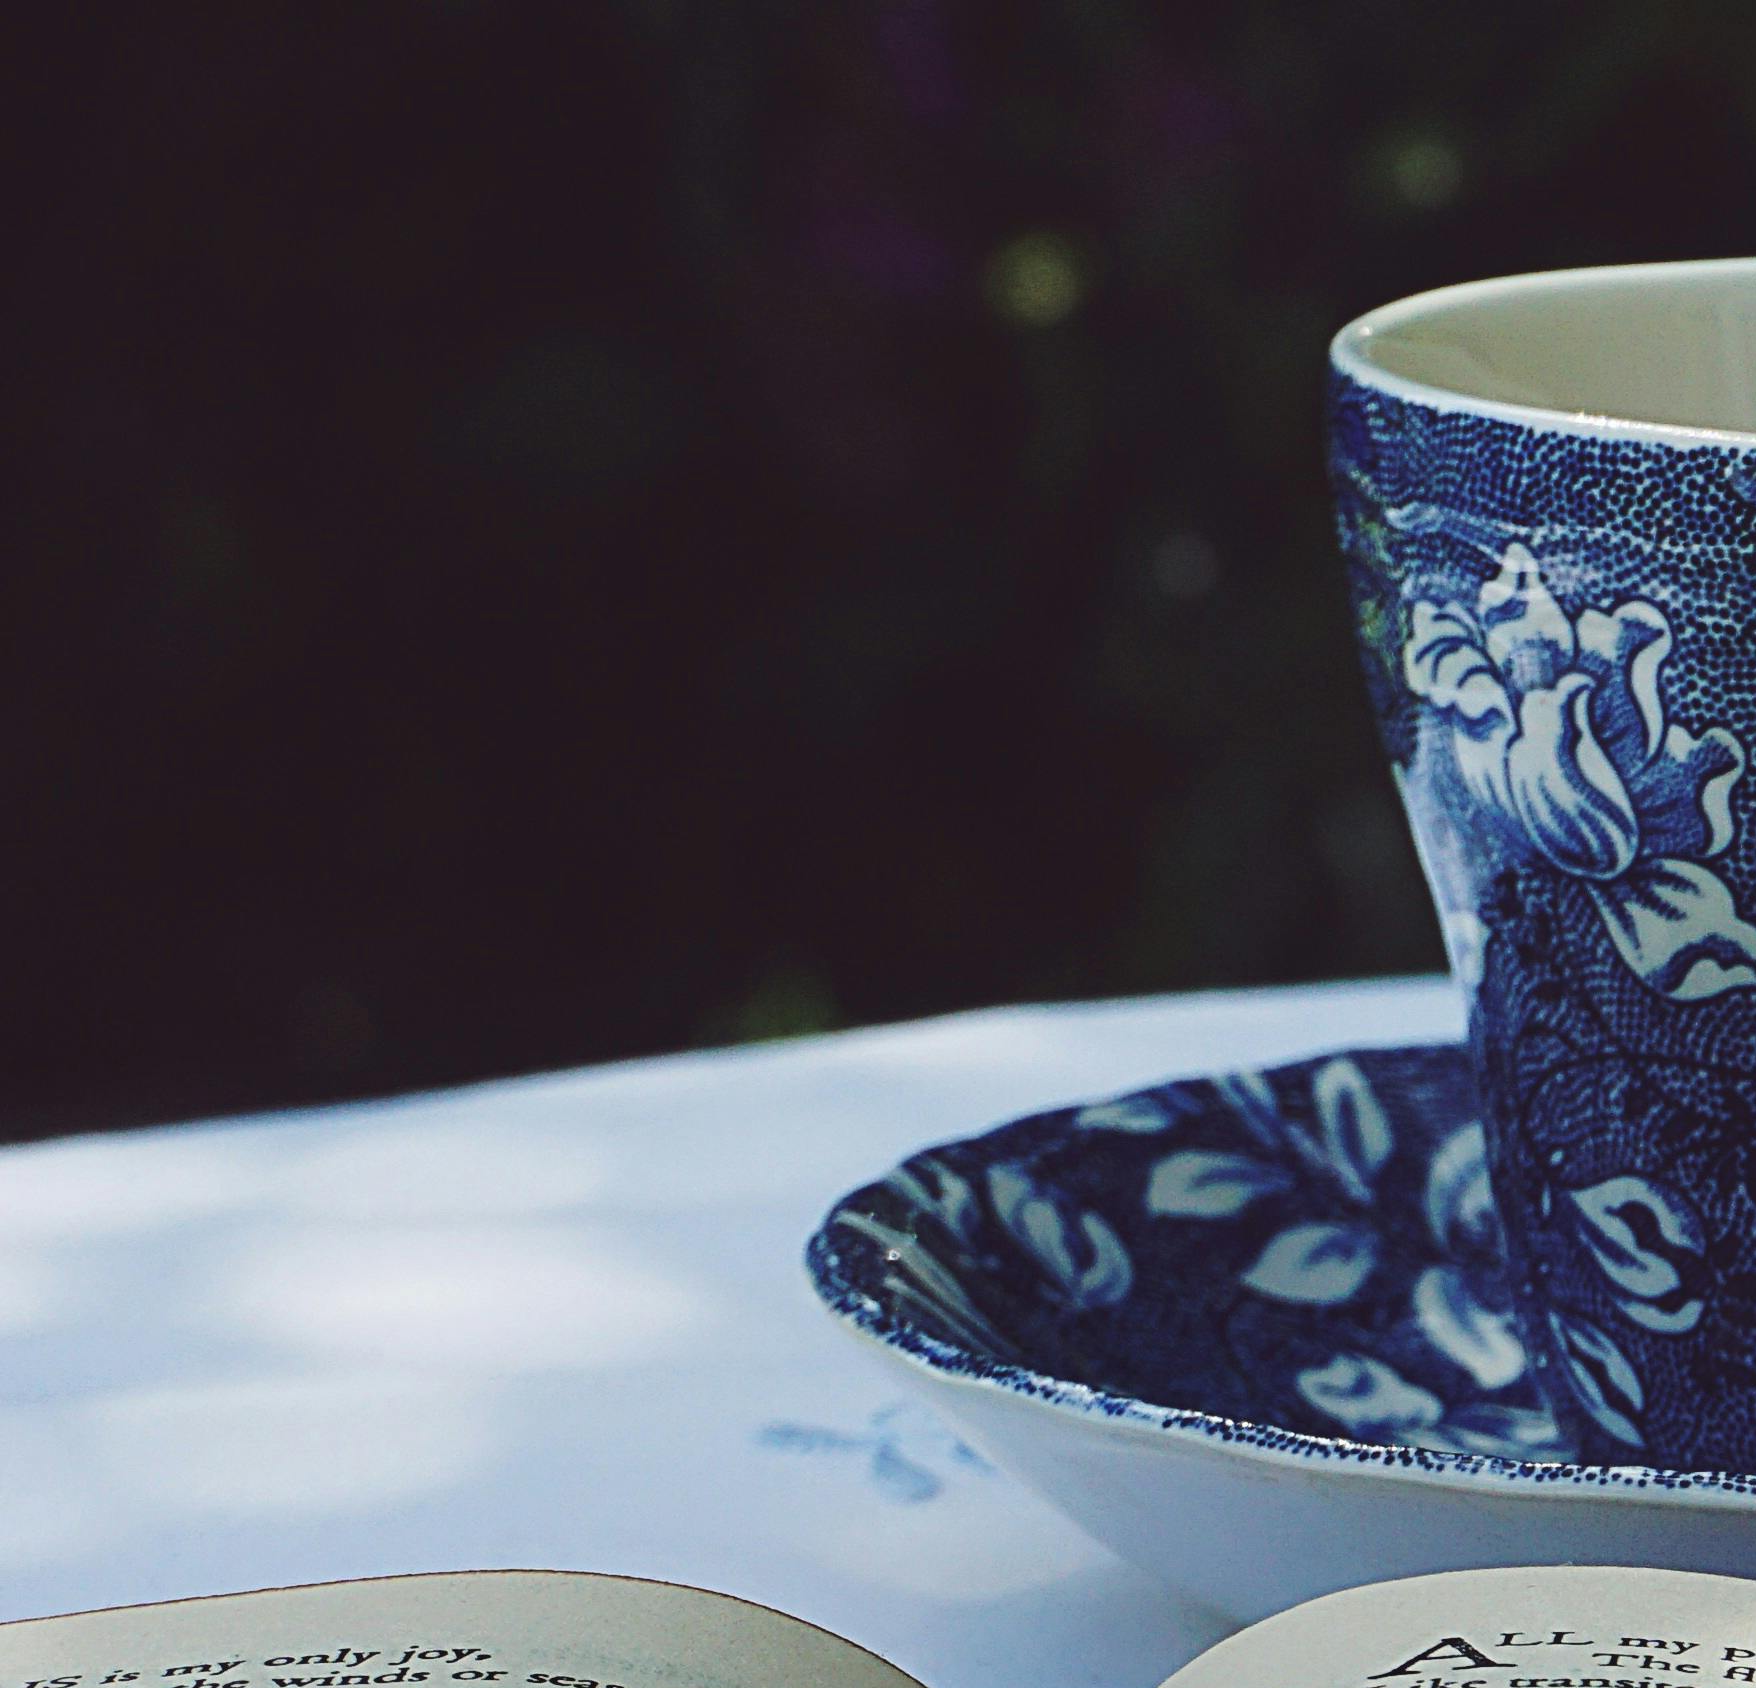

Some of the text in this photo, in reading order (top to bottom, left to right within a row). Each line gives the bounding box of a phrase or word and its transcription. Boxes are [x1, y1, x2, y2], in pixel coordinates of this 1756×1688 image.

[99, 1669, 142, 1685] is
[161, 1659, 248, 1677] my
[263, 1647, 382, 1667] only
[1366, 1630, 1595, 1681] ALL
[1618, 1635, 1702, 1655] my
[1591, 1651, 1702, 1675] The
[271, 1667, 431, 1688] winds
[451, 1669, 508, 1682] or
